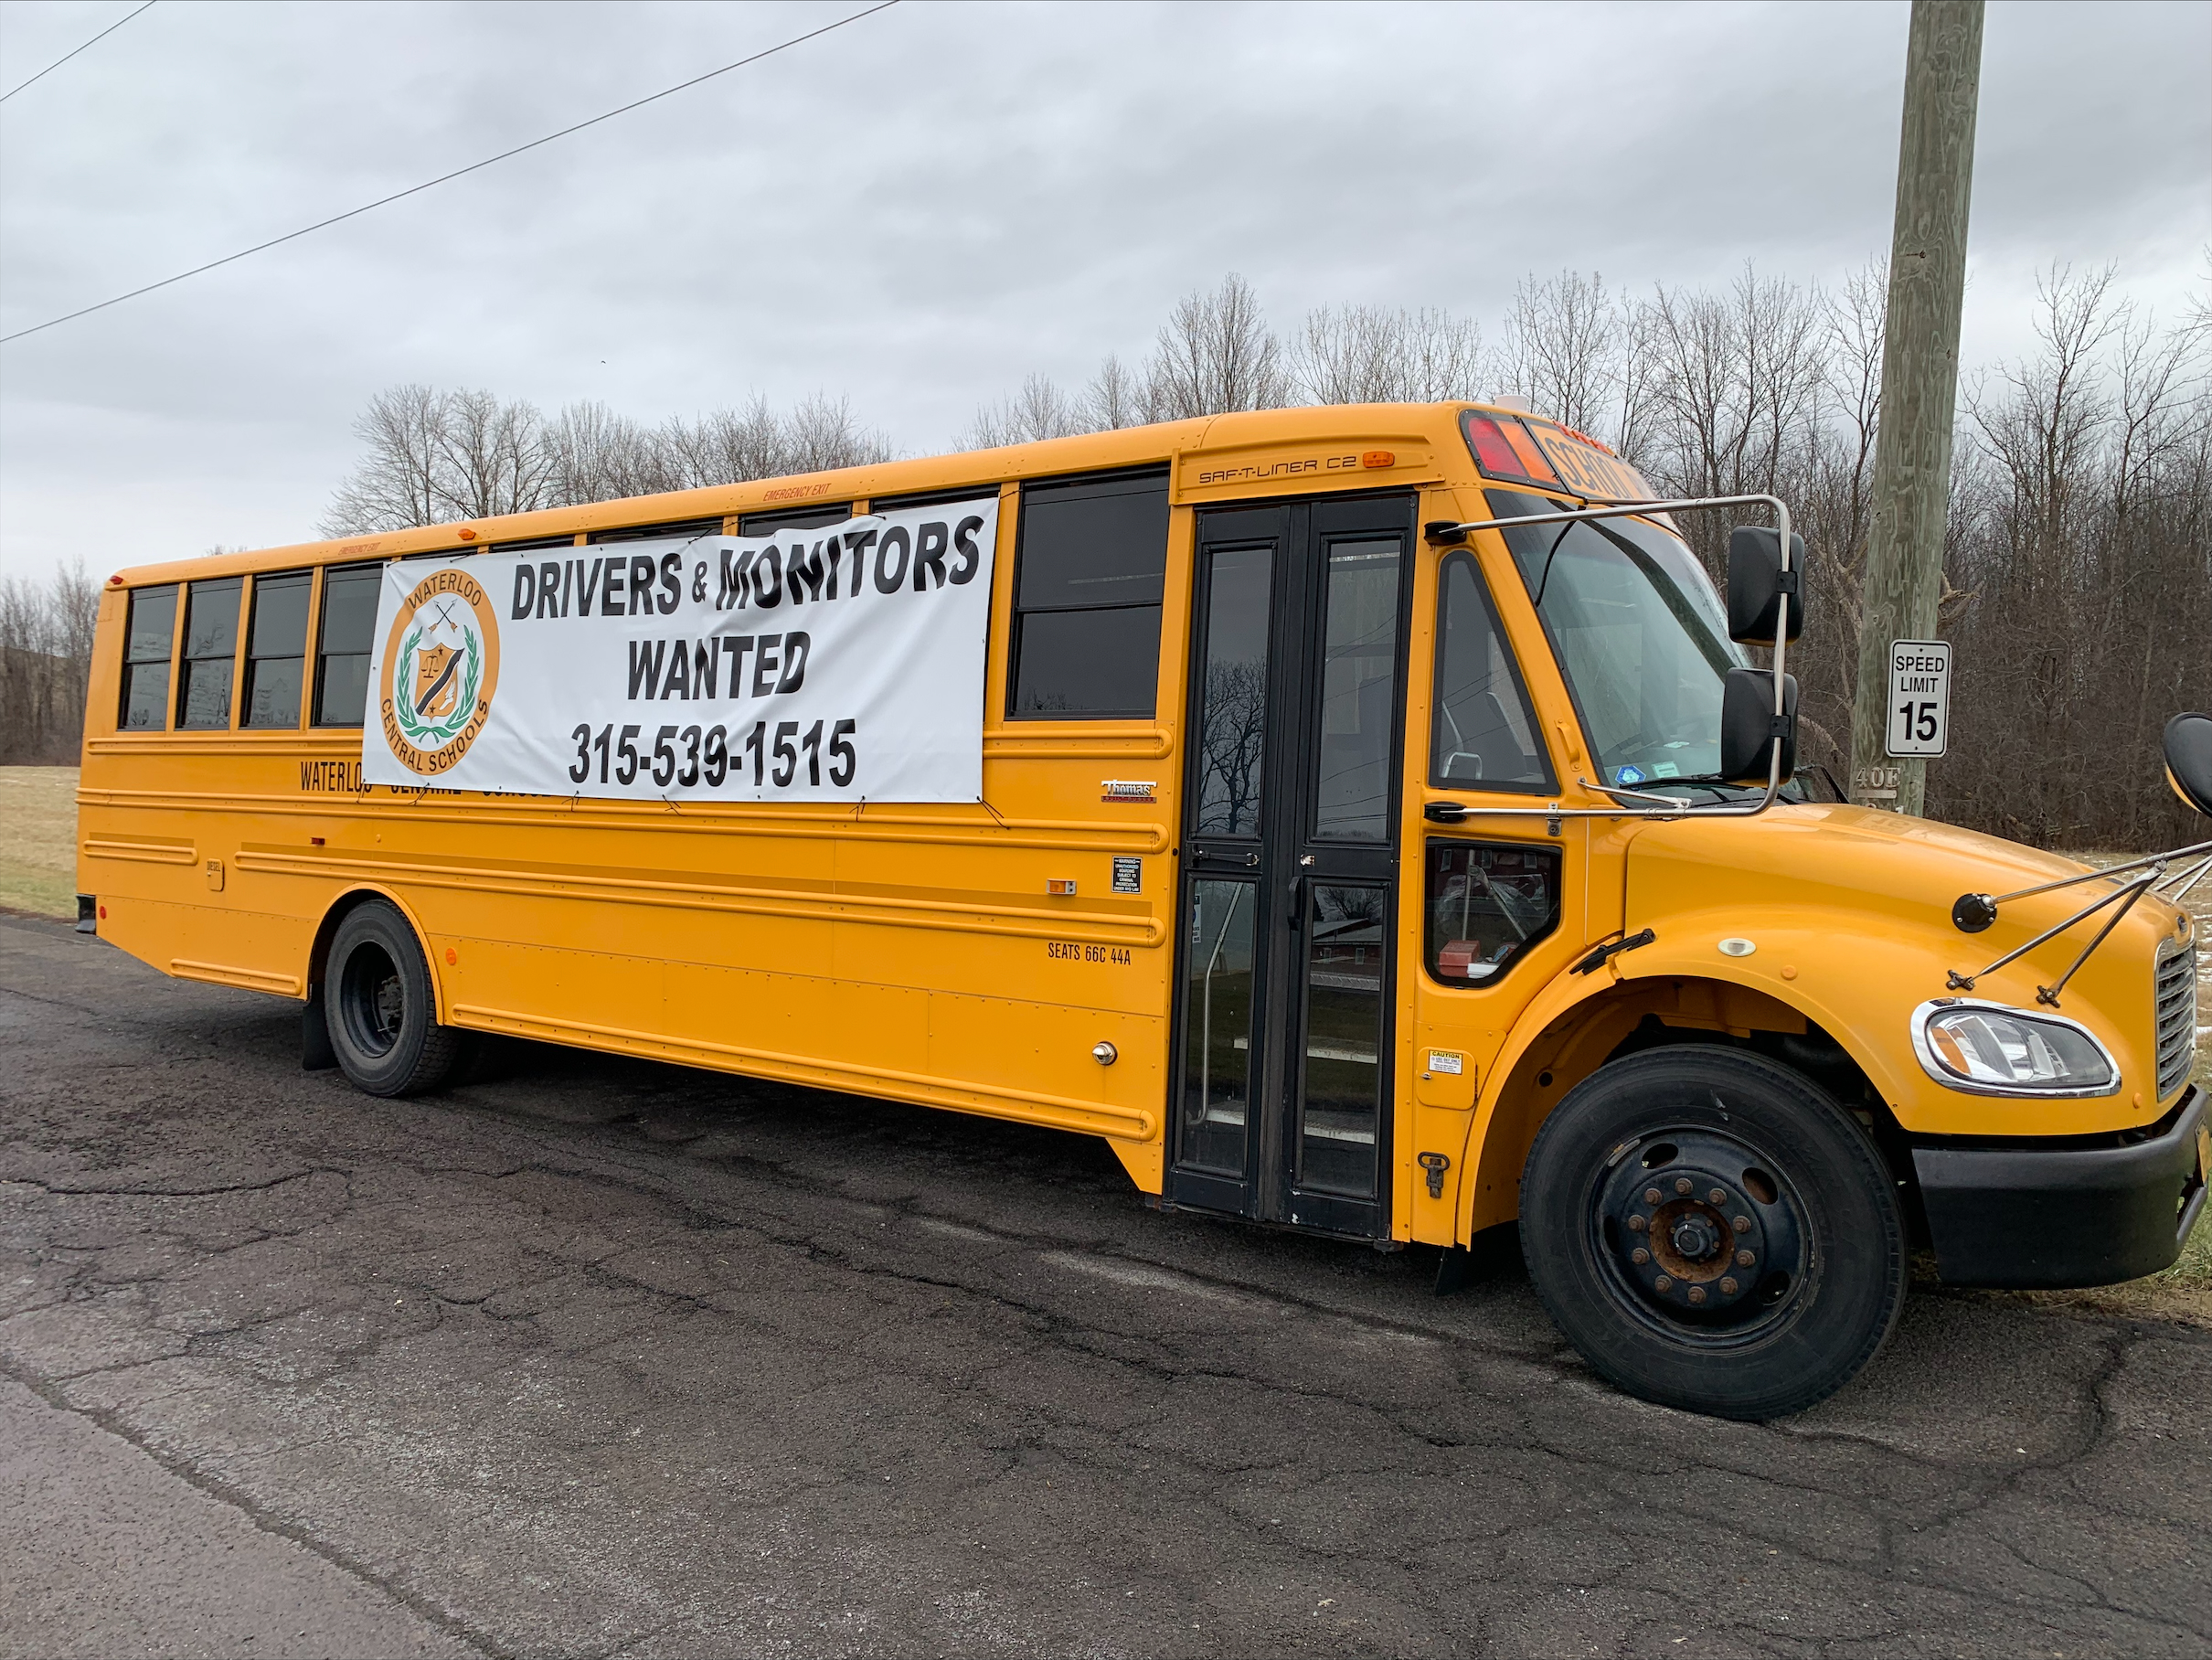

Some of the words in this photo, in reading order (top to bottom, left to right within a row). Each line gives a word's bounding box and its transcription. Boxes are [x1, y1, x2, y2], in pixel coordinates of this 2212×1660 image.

[1199, 460, 1318, 484] SAF-T-LINER
[1326, 456, 1356, 469] C2
[762, 485, 813, 502] EMERGENCY
[811, 483, 832, 496] EXIT
[511, 552, 682, 621] DRIVERS
[692, 560, 707, 603] &
[716, 515, 984, 611] MONITORS
[408, 572, 482, 610] WATERLOO
[627, 631, 812, 701] WANTED
[1895, 655, 1945, 673] SPEED
[1900, 676, 1939, 693] LIMIT
[381, 697, 423, 771] CENTRAL
[429, 698, 488, 772] SCHOOLS
[1899, 701, 1938, 741] 15
[568, 718, 856, 788] 315-539-1515
[1101, 779, 1157, 796] Thomas
[207, 860, 221, 872] DIESEL
[1048, 942, 1080, 960] SEATS
[1085, 945, 1106, 963] 66C
[1111, 948, 1131, 965] 44A
